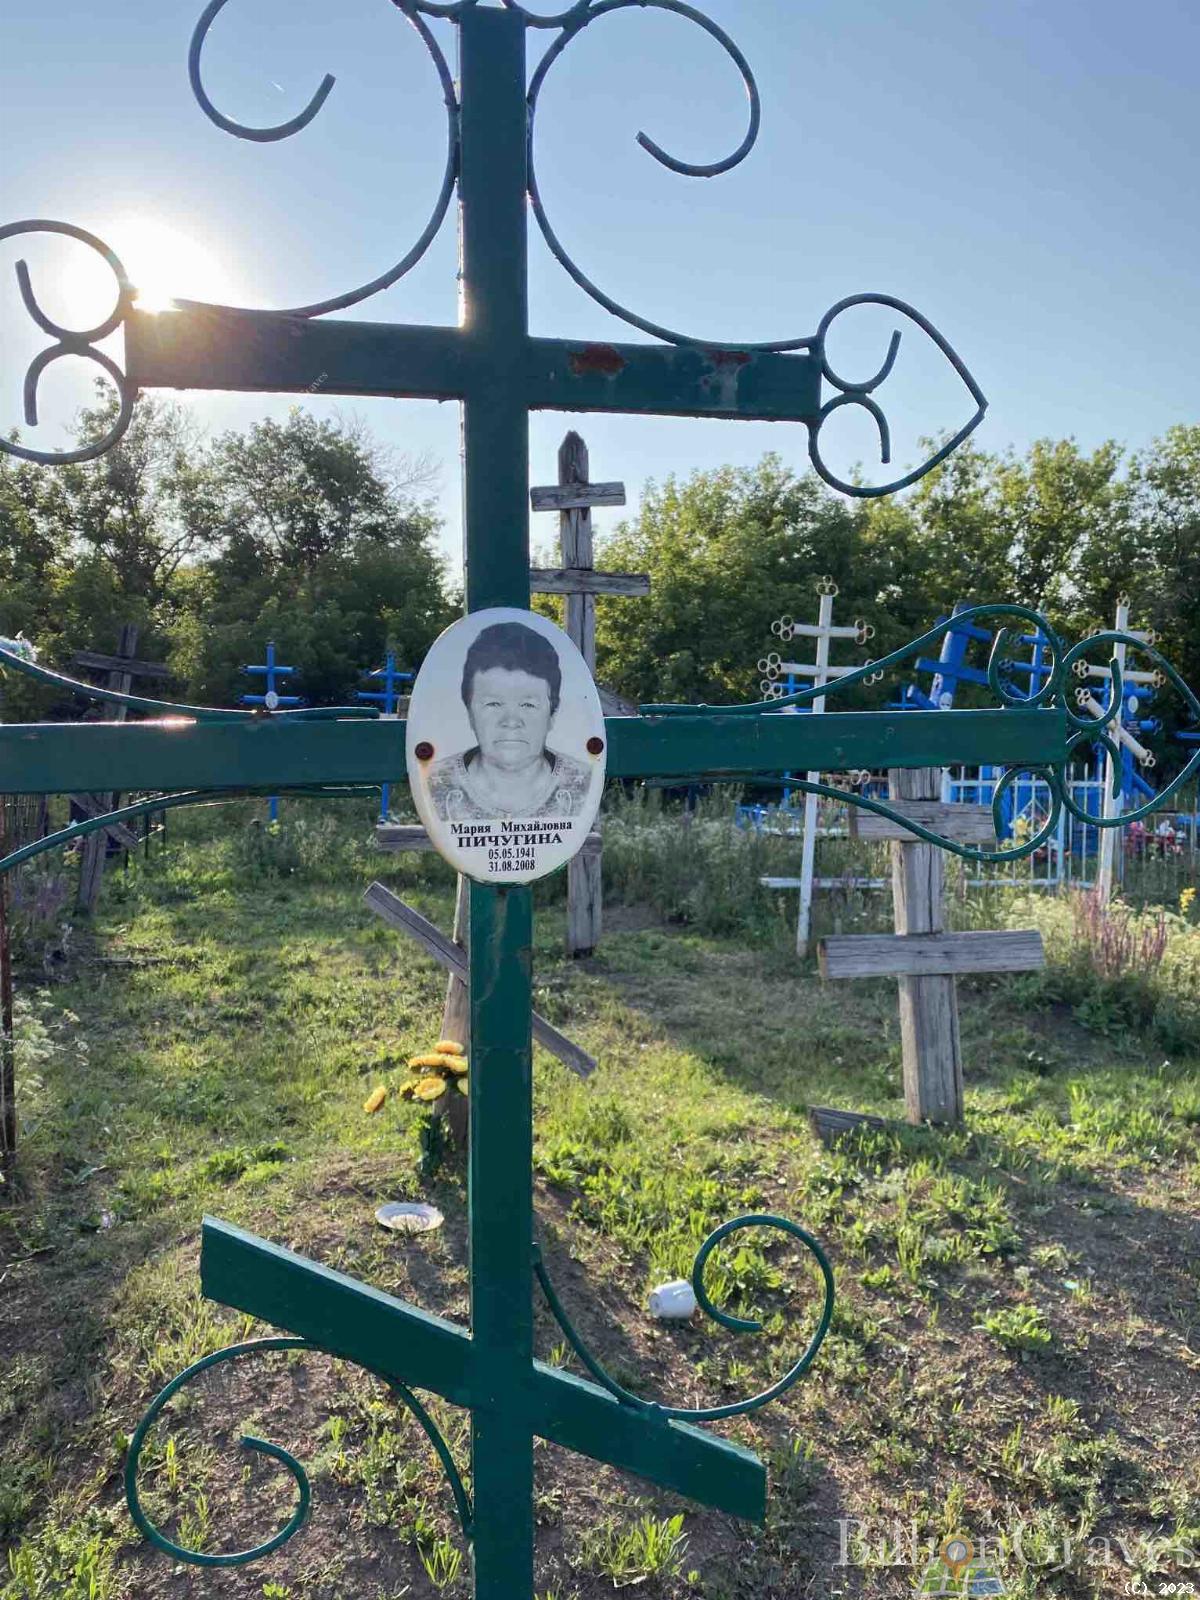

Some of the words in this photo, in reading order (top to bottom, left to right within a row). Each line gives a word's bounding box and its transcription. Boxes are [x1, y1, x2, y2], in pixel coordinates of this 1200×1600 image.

[450, 823, 491, 836] Мария
[501, 821, 572, 832] Михайловна
[458, 833, 562, 848] ПИЧУГИНА
[488, 847, 535, 859] 05.05.1941
[488, 860, 535, 872] 31.08.2008
